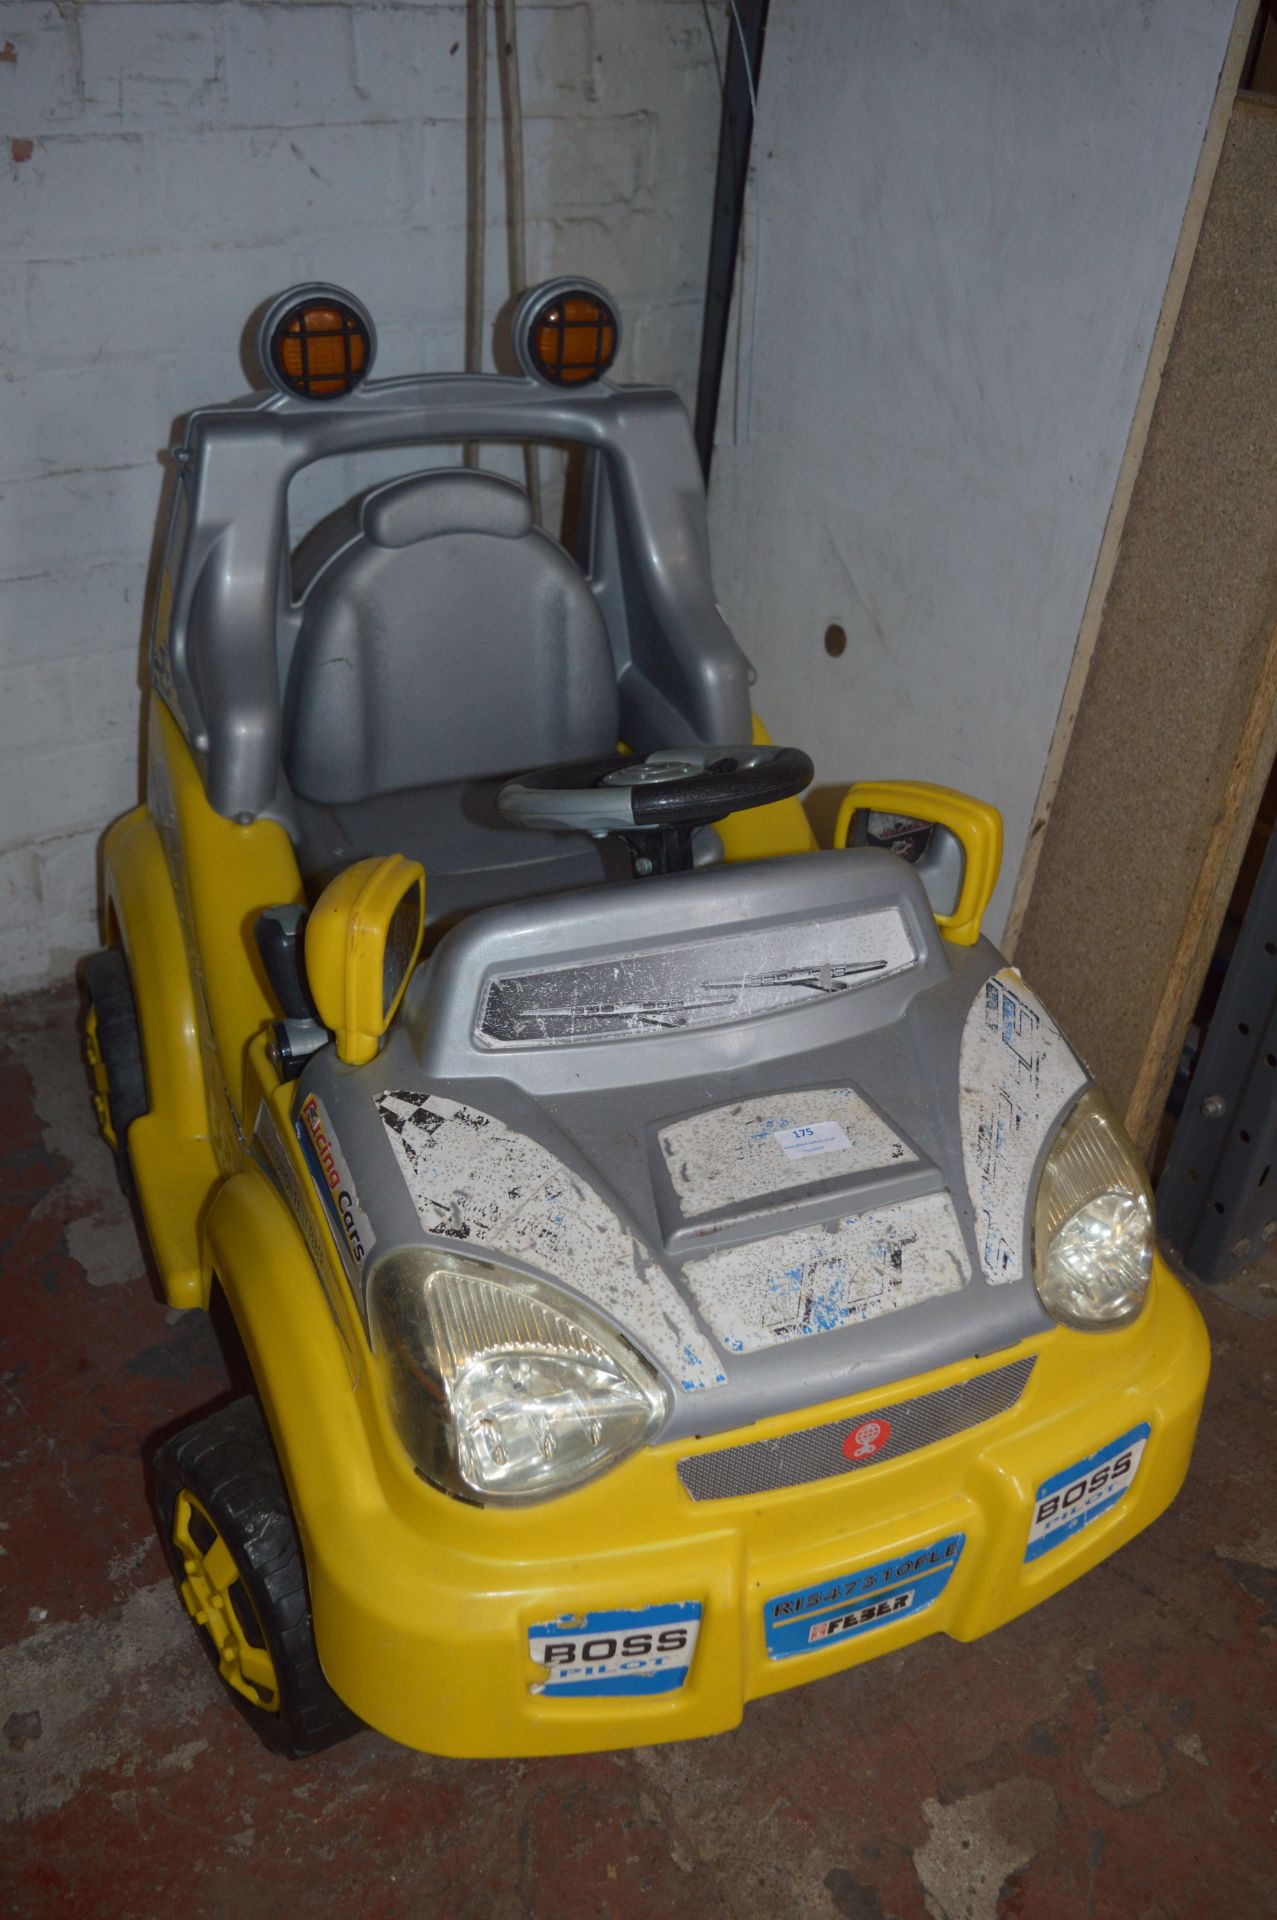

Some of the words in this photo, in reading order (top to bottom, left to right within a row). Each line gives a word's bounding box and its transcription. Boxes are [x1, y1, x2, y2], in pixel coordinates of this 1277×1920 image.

[792, 1127, 814, 1138] 175
[339, 1190, 365, 1262] Cars
[1036, 1451, 1133, 1524] BOSS
[1044, 1483, 1118, 1529] PILOT
[827, 1593, 910, 1635] FEBER
[543, 1628, 688, 1664] BOSS
[559, 1657, 671, 1678] PILOT
